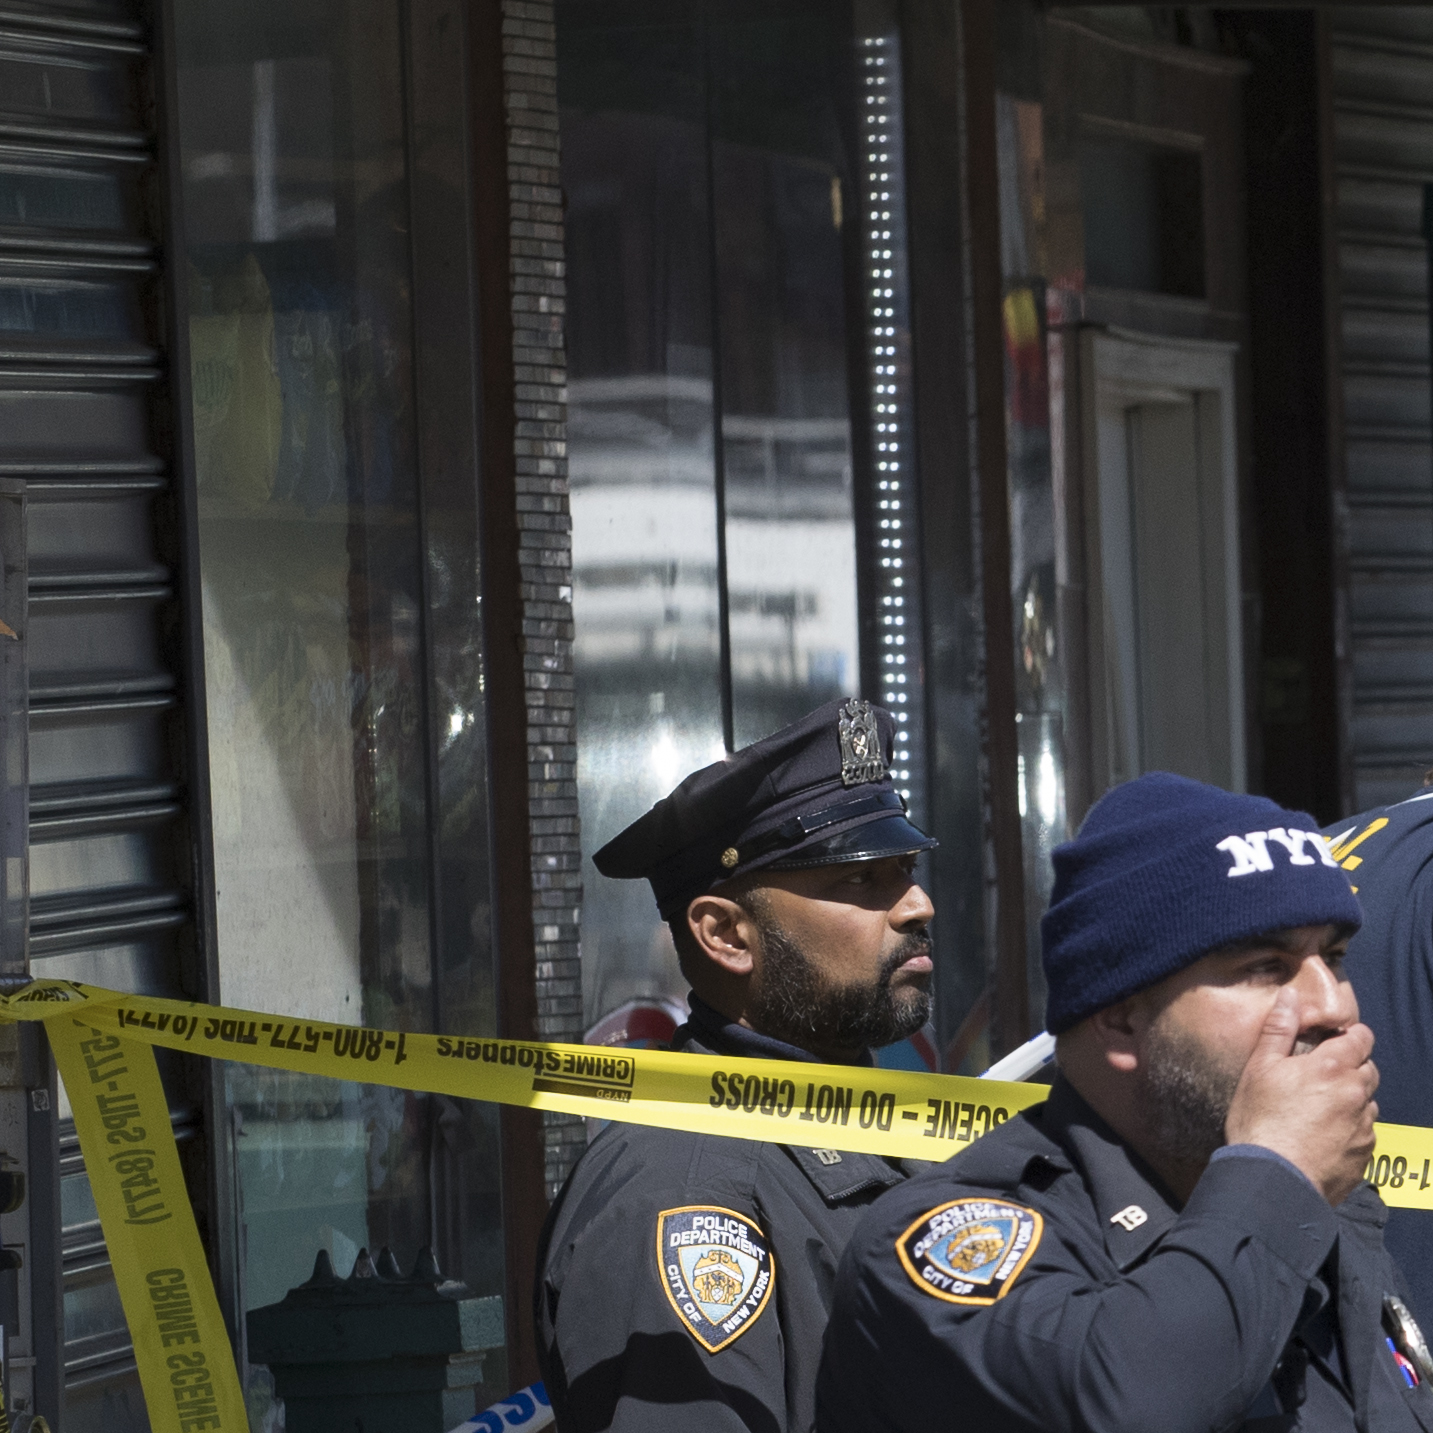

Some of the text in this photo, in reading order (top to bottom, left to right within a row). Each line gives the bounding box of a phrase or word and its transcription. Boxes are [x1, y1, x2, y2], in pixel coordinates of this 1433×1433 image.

[709, 1071, 796, 1119] CROSS
[800, 1083, 853, 1126] NOT
[859, 1090, 896, 1132] DO
[669, 1229, 766, 1262] DEPARTMENT
[692, 1216, 748, 1238] POLICE
[667, 1264, 702, 1322] CITY OF
[722, 1269, 770, 1334] NEW YORK
